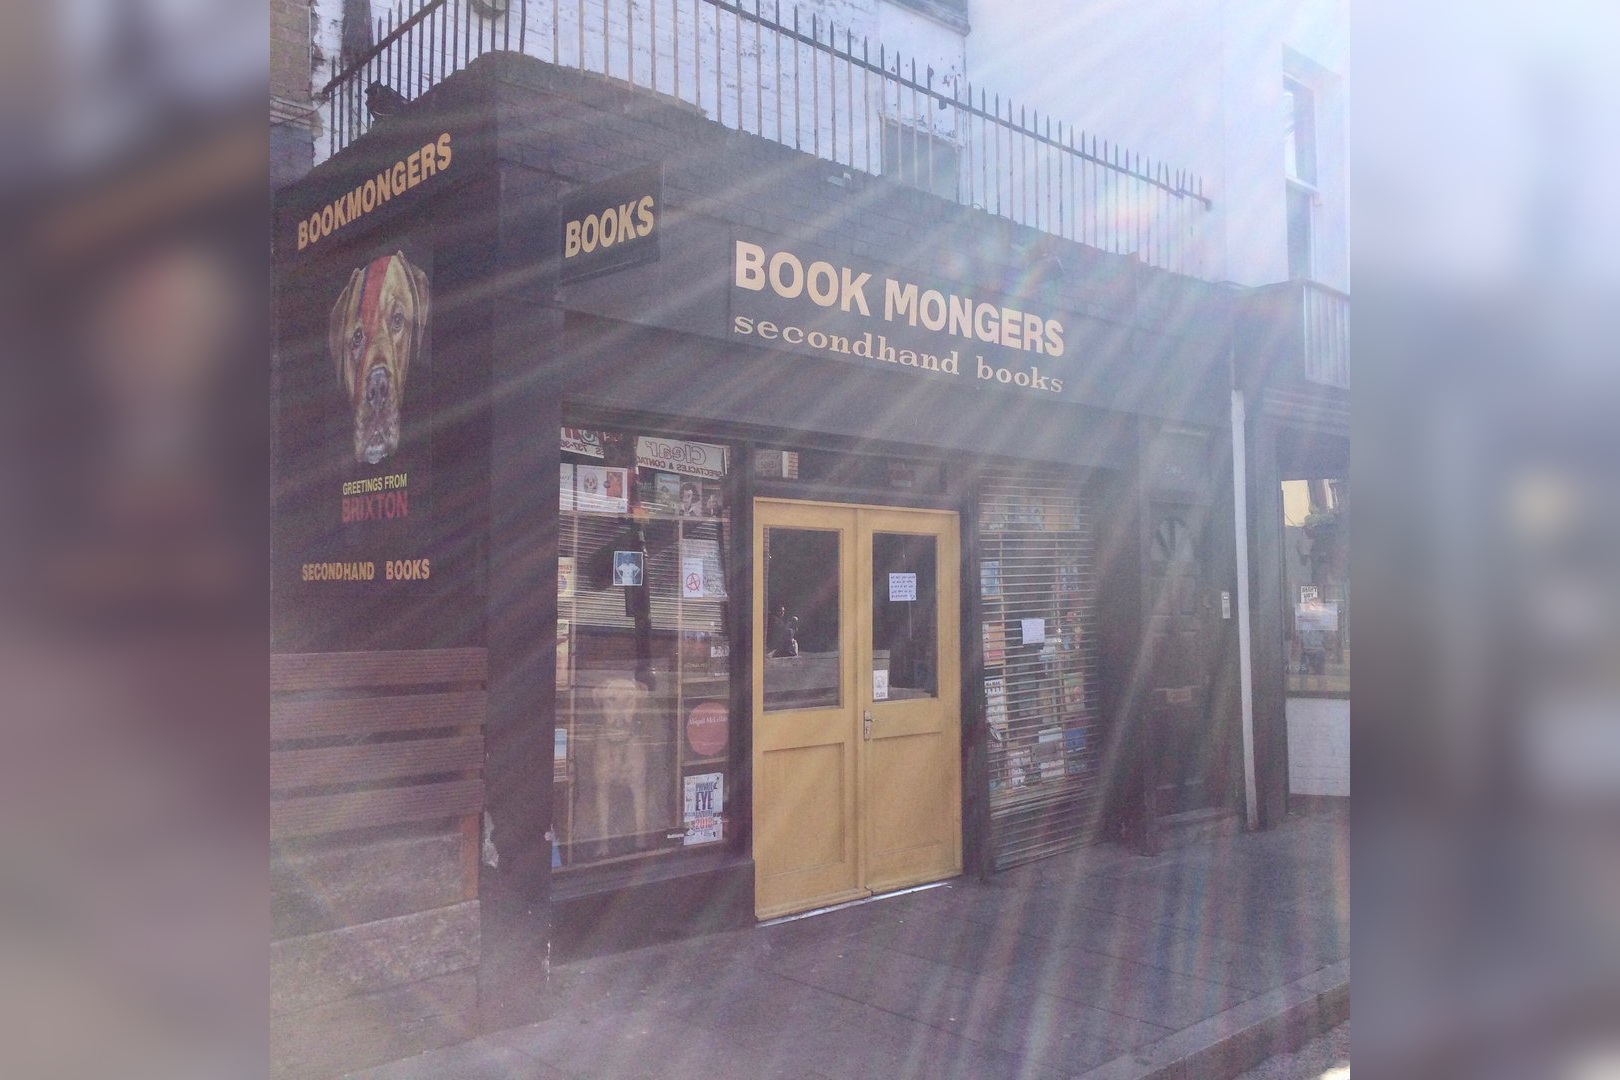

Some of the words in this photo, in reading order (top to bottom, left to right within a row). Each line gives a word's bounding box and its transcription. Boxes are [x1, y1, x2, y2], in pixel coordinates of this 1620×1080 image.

[298, 132, 453, 251] BOOKMONGERS
[565, 195, 655, 259] BOOKS
[735, 240, 872, 317] BOOK
[884, 278, 1065, 357] MONGERS
[734, 315, 960, 376] secondhand
[976, 355, 1063, 394] books
[342, 477, 383, 496] GREETINGS
[384, 473, 407, 490] FROM
[342, 490, 408, 524] BRIXTON
[302, 561, 375, 582] SECONDHAND
[386, 558, 430, 581] BOOKS
[696, 790, 714, 811] EYE
